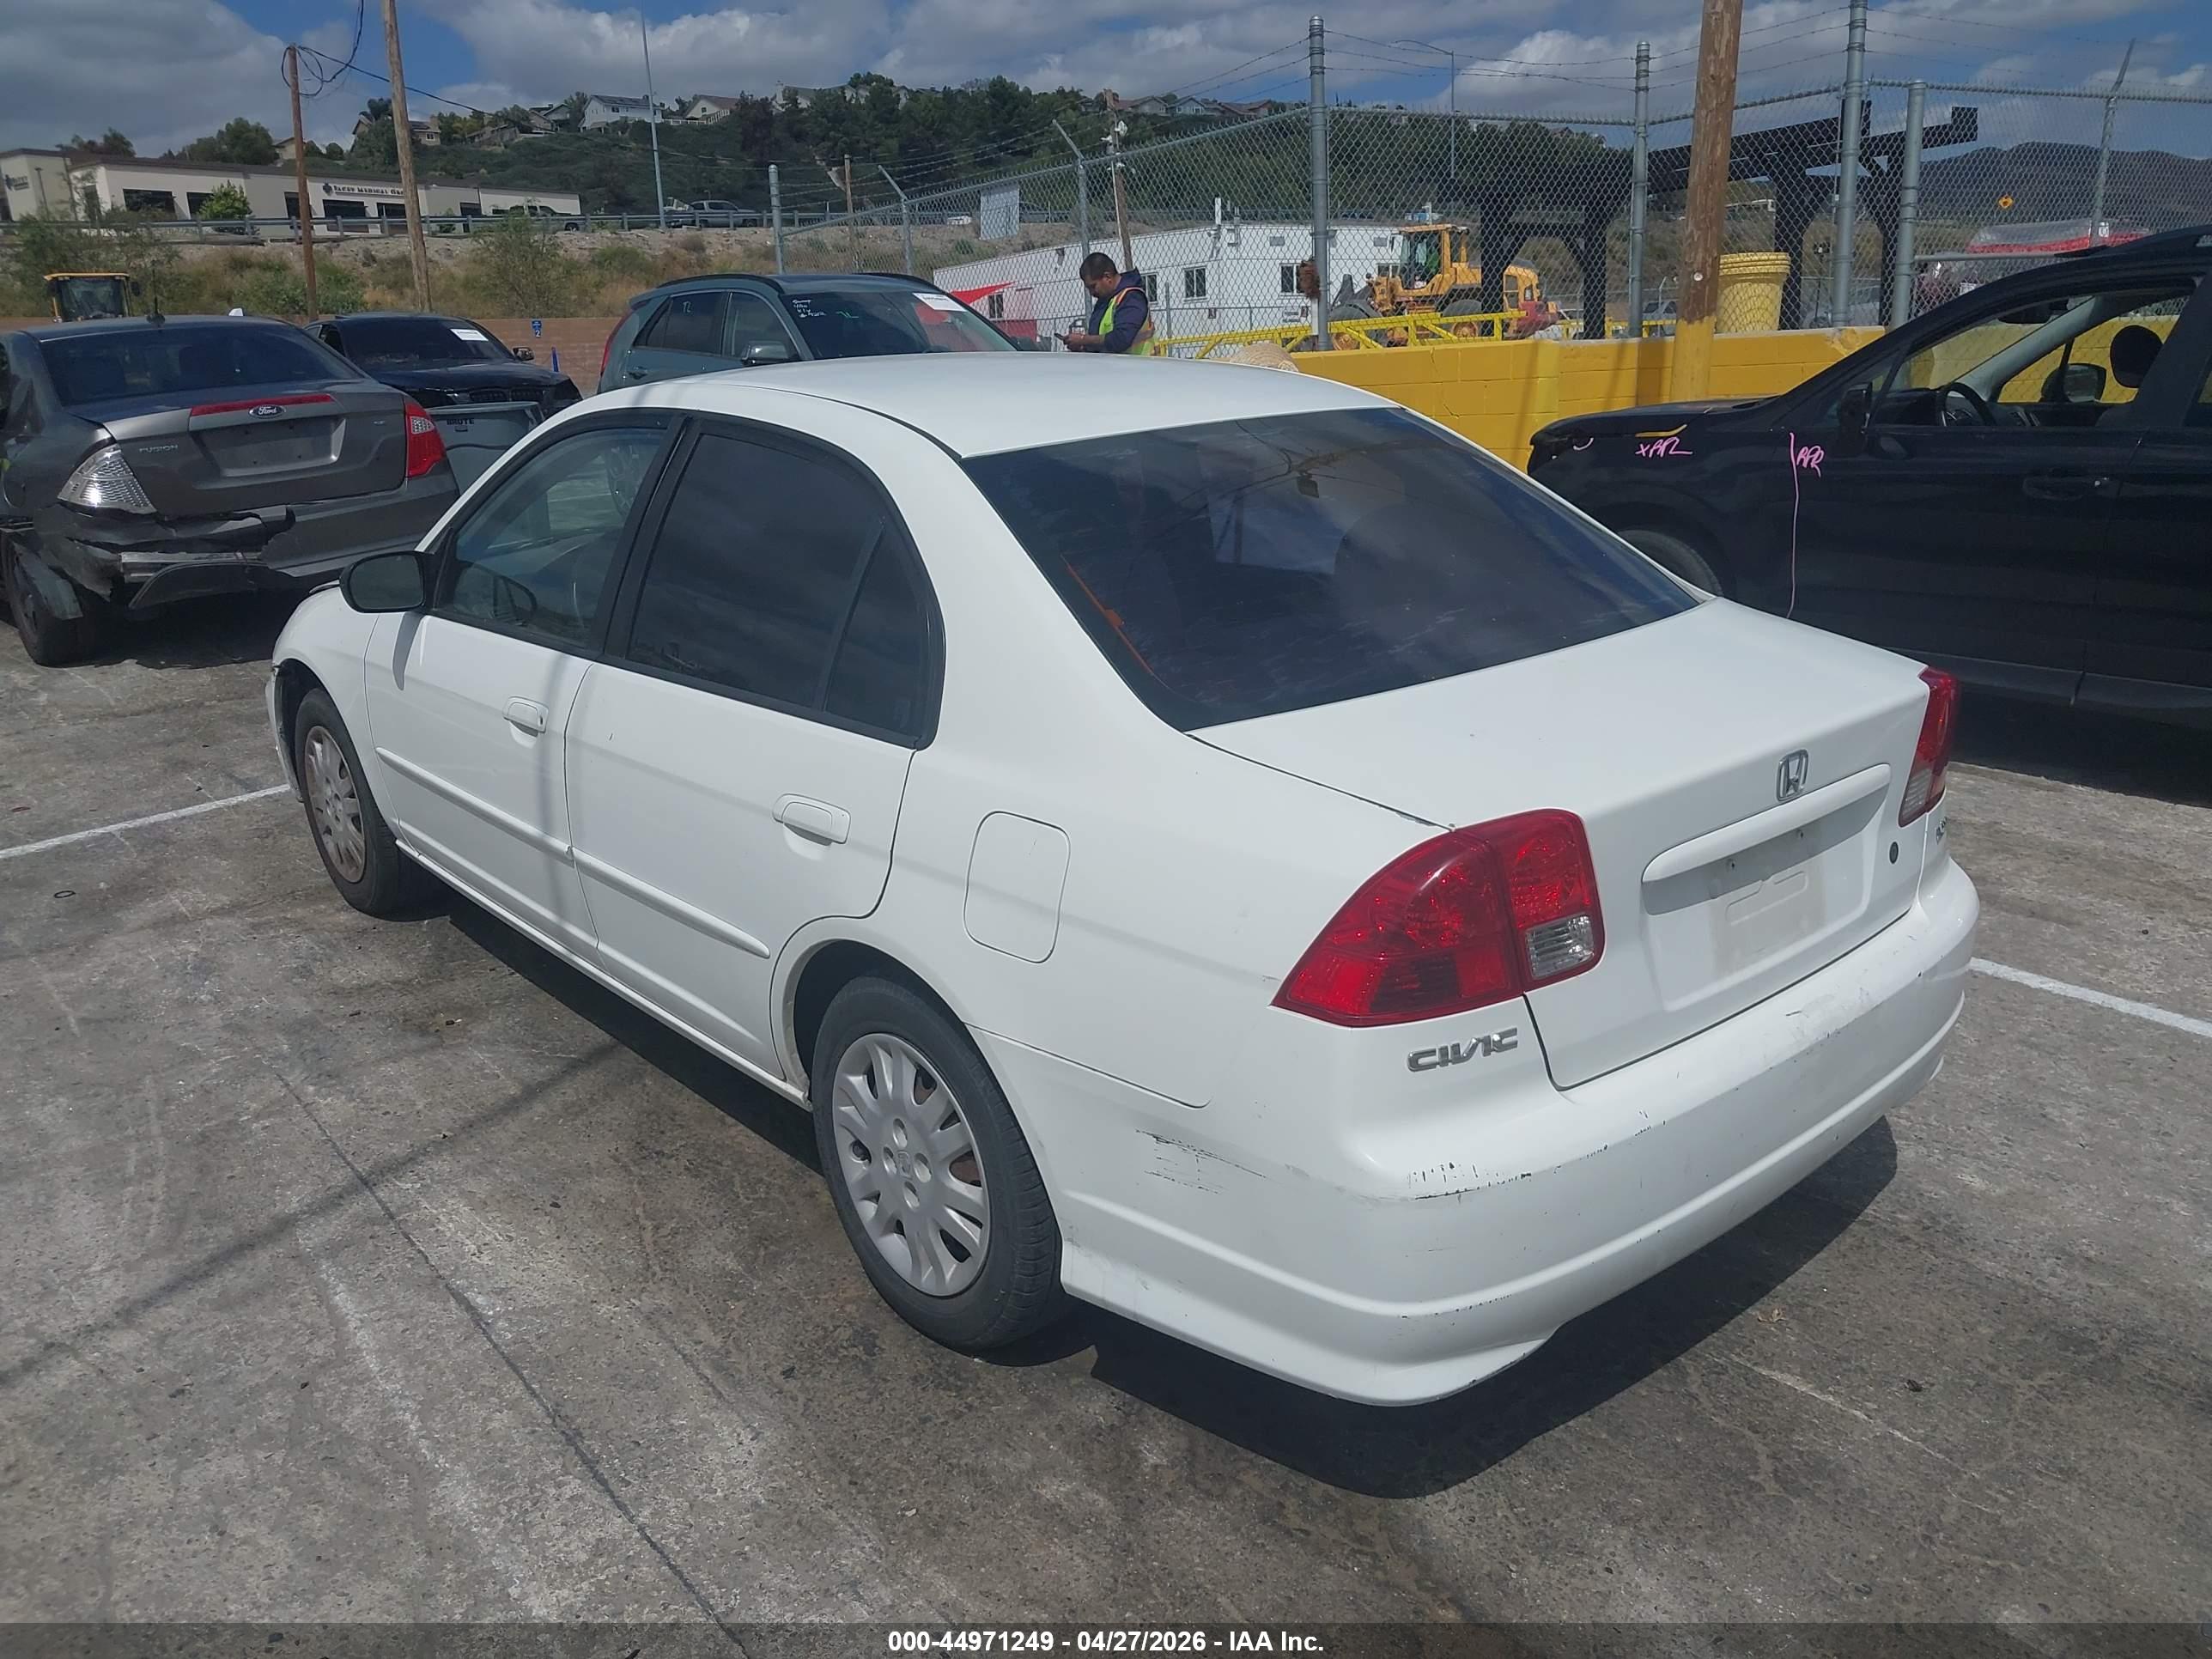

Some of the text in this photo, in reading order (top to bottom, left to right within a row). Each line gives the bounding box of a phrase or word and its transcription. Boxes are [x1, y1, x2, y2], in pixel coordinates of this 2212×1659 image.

[258, 405, 277, 416] Ford
[138, 444, 179, 453] FUSION
[1407, 1027, 1518, 1073] CIVIC
